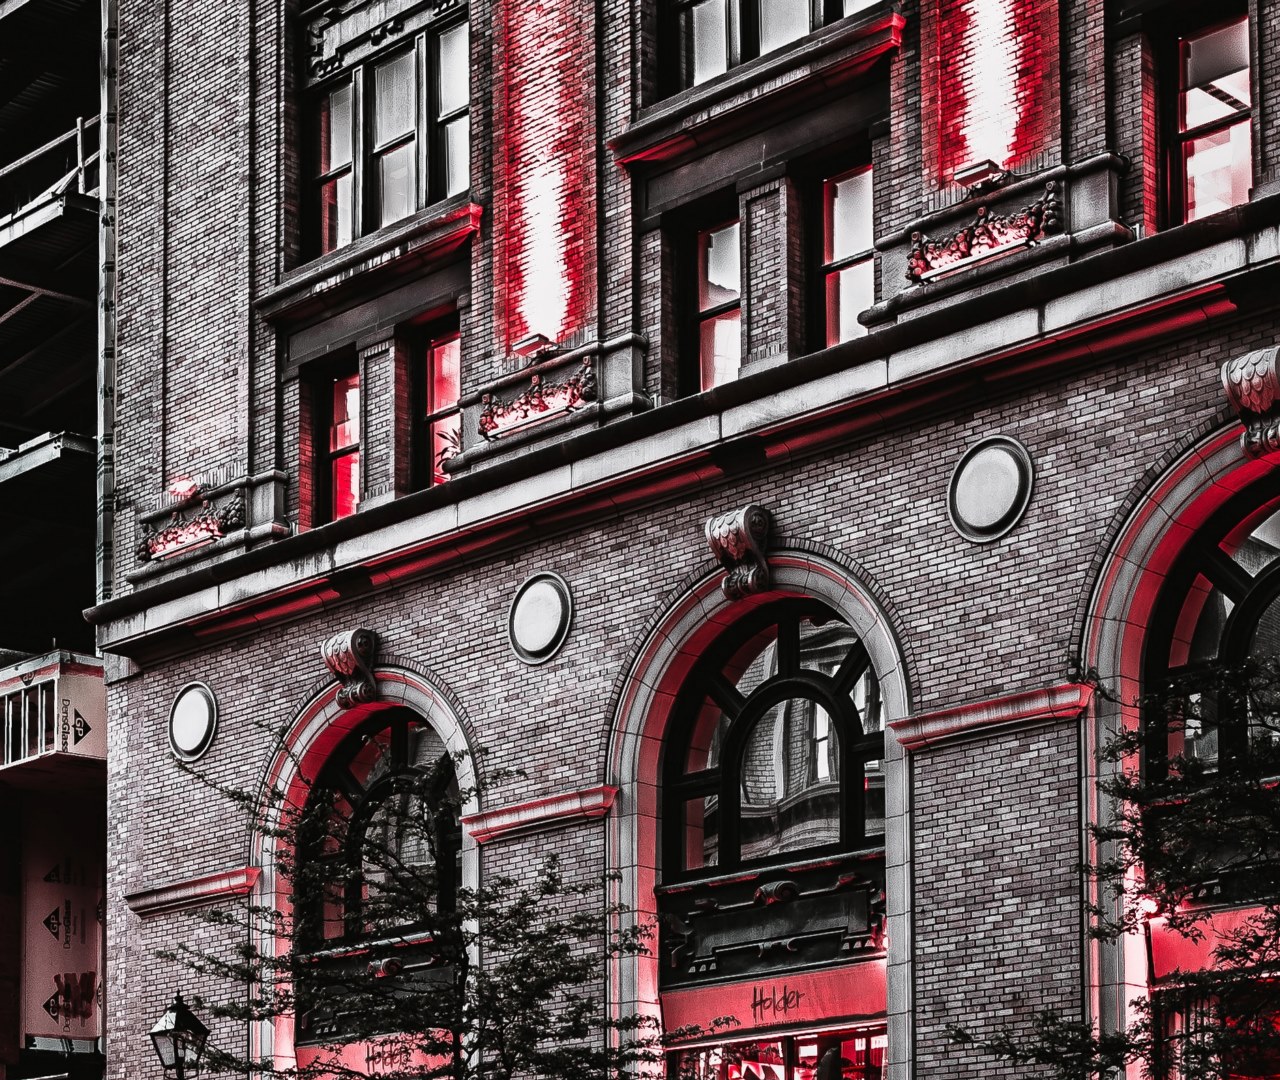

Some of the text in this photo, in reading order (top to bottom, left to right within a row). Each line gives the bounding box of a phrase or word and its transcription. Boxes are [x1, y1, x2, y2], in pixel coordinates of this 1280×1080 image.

[75, 717, 84, 737] GP
[50, 915, 58, 933] GP
[750, 984, 806, 1023] Holder
